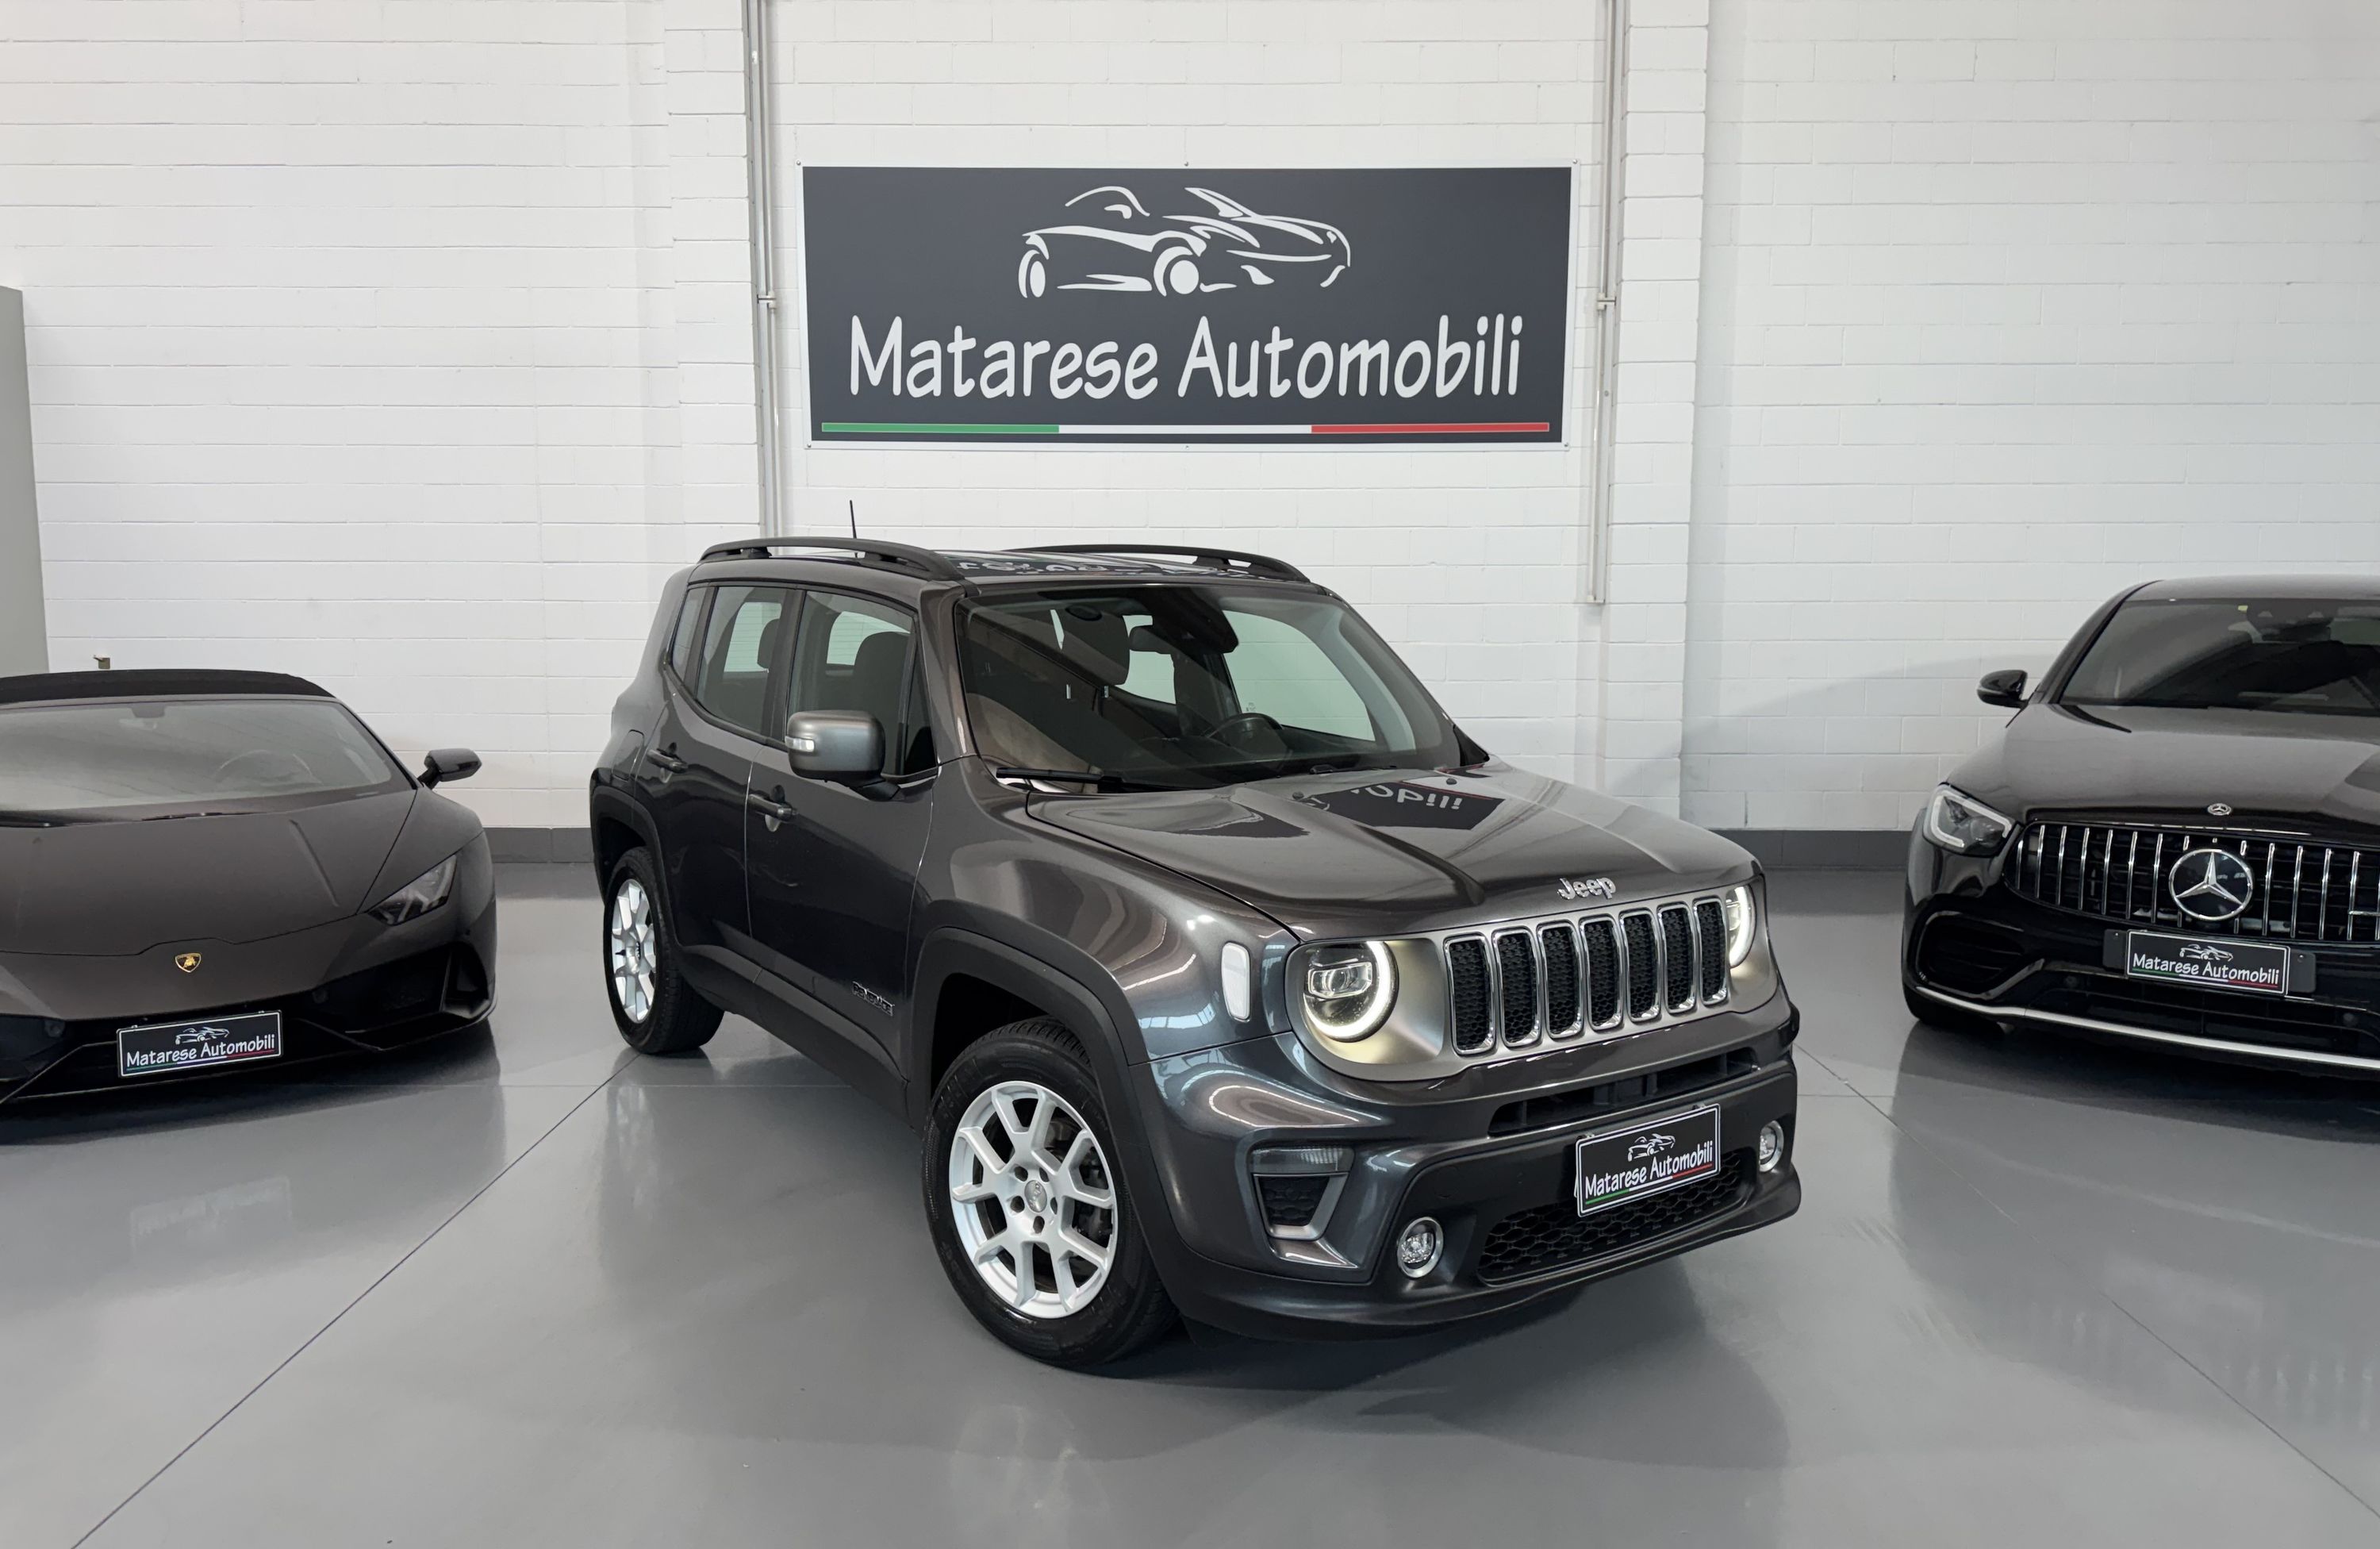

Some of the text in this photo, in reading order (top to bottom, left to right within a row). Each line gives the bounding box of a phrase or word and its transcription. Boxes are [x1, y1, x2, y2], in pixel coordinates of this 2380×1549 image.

[850, 313, 1522, 400] Matarese Automobili
[1557, 877, 1616, 900] Jeep
[2132, 953, 2279, 984] Matarese Automobili
[126, 1034, 275, 1067] Matarese Automobili
[1585, 1140, 1713, 1199] Matarese Automobili
